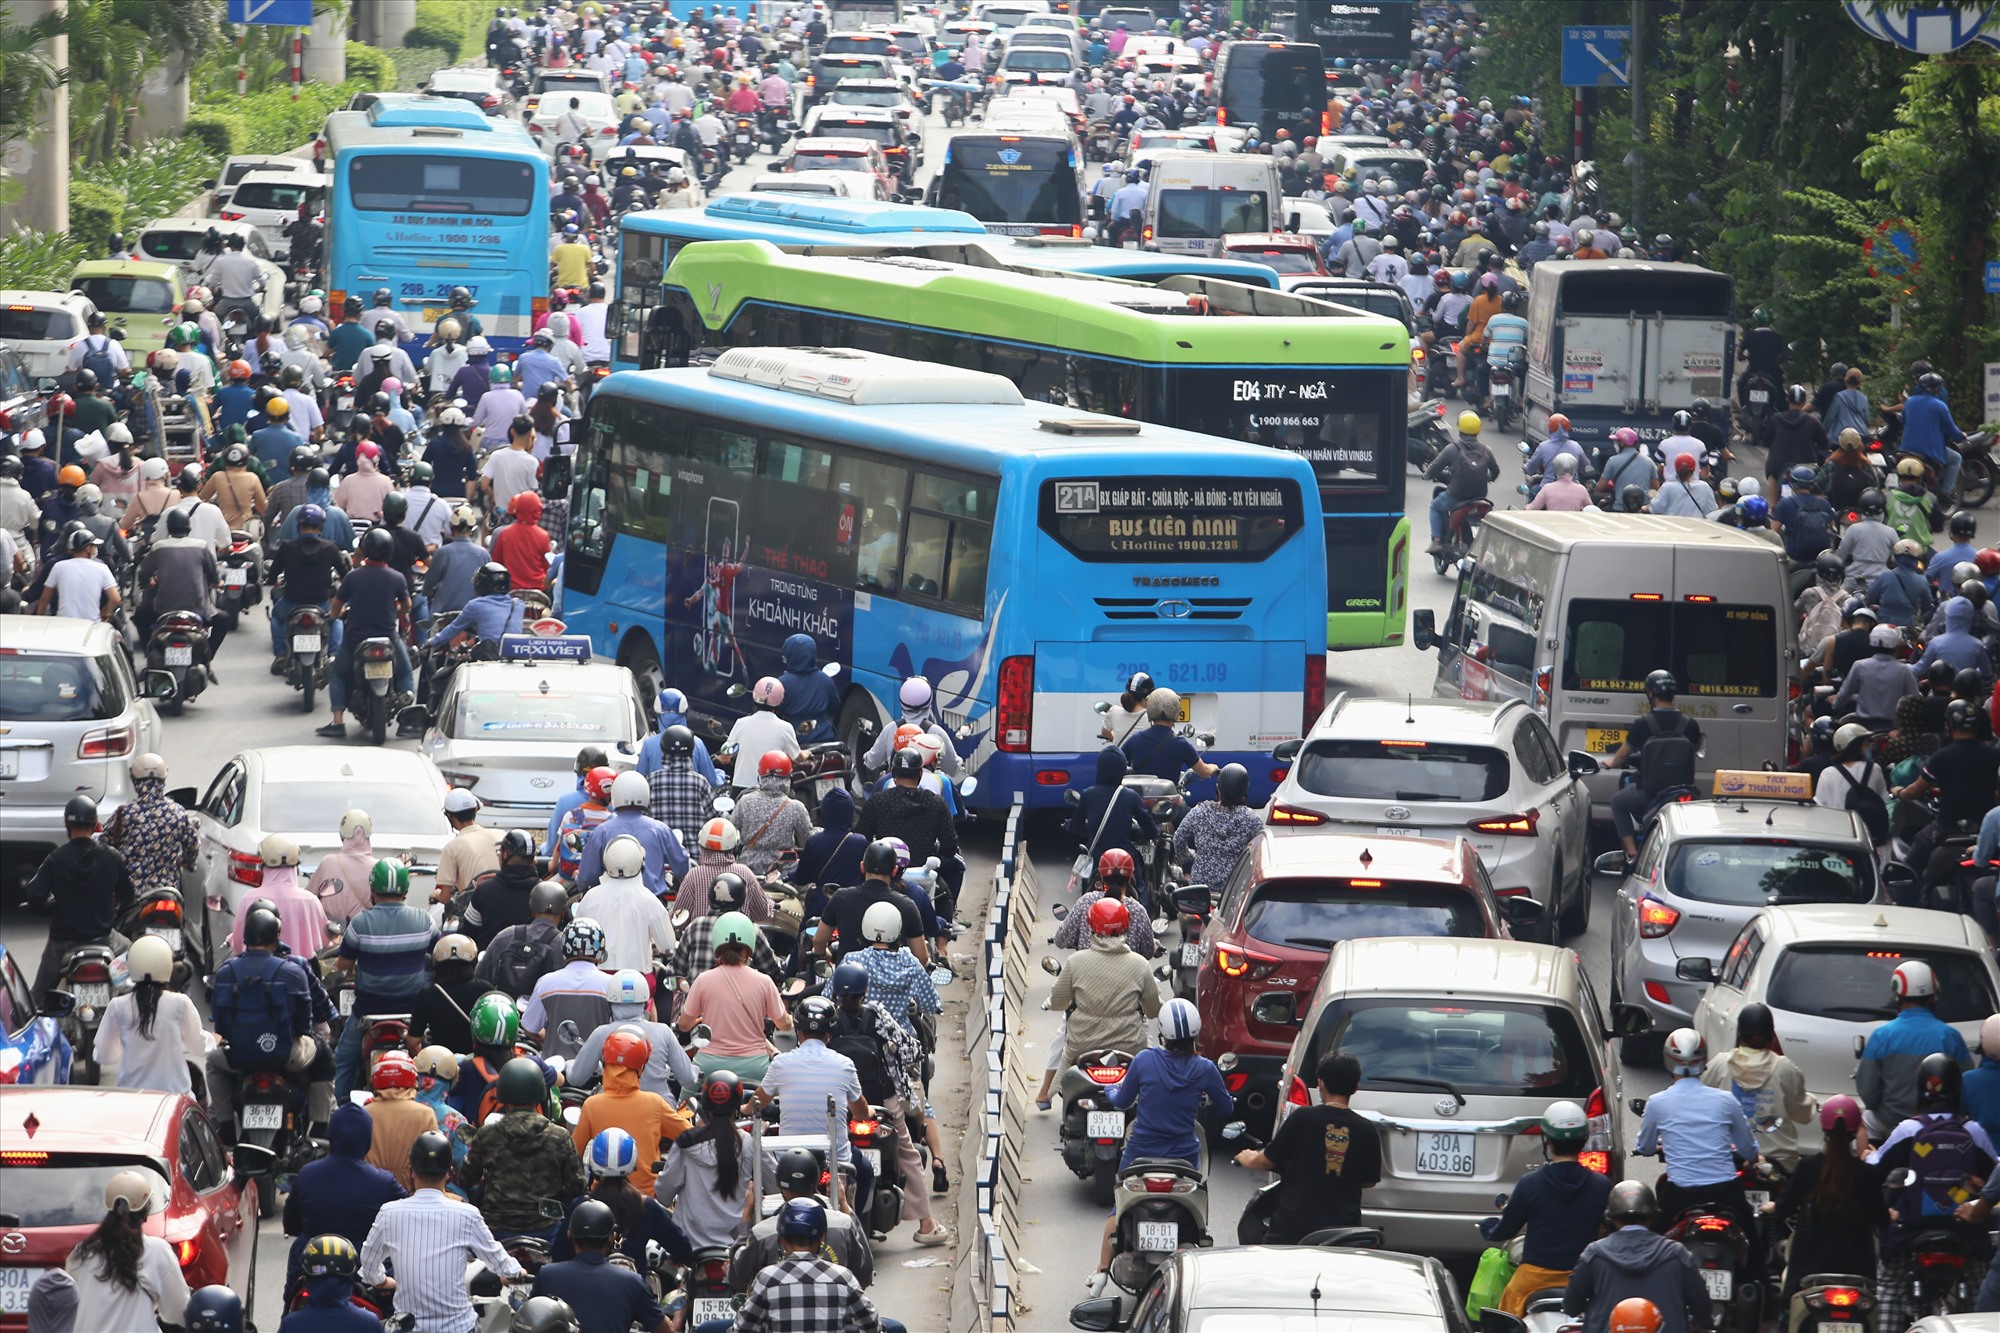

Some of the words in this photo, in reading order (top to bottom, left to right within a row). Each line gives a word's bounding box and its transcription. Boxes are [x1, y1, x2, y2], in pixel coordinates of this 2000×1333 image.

[1233, 381, 1261, 401] E04
[1258, 416, 1281, 426] 1900
[1283, 416, 1300, 426] 866
[1302, 416, 1319, 426] 663
[1313, 448, 1332, 461] NHÂN
[1333, 447, 1348, 461] VIÊN
[1349, 450, 1373, 462] VINBUS
[677, 467, 704, 485] vinaphone
[1059, 485, 1095, 510] 21A
[1100, 491, 1111, 506] BX
[1112, 487, 1130, 507] GIÁP
[1131, 487, 1146, 507] BÁT
[1152, 488, 1172, 507] CHÙA
[1174, 488, 1189, 510] BỘC
[1195, 488, 1205, 507] HÀ
[1206, 488, 1227, 507] ĐÔNG
[1233, 491, 1244, 508] BX
[1245, 488, 1260, 508] YÊN
[1261, 488, 1283, 508] NGHĨA
[1109, 519, 1144, 536] BUS
[1192, 519, 1238, 536] NINH
[1122, 540, 1175, 551] Hotline
[793, 555, 828, 577] THAO
[770, 578, 796, 596] TRONG
[1132, 576, 1220, 588] TRACOMECO
[1345, 598, 1381, 607] GREEN
[748, 597, 801, 630] KHOẢNH
[803, 607, 838, 639] KHẮC
[512, 645, 547, 655] TAXI
[1168, 662, 1229, 682] 621.09
[1567, 696, 1610, 706] TRANSIT
[1599, 730, 1620, 741] 29B
[1766, 775, 1787, 784] TAXI
[1748, 783, 1781, 793] THANH
[1828, 860, 1843, 869] 171
[250, 1106, 276, 1116] 36-B7
[245, 1116, 279, 1128] 058.26
[1093, 1113, 1119, 1125] 99-F1
[1089, 1125, 1122, 1136] 614.49
[1430, 1133, 1461, 1153] 30A
[1417, 1152, 1472, 1173] 403.86
[1146, 1224, 1172, 1236] 18-B1
[1140, 1237, 1176, 1250] 267.25
[1702, 1272, 1725, 1285] 9-T2
[701, 1300, 731, 1313] 15-B2
